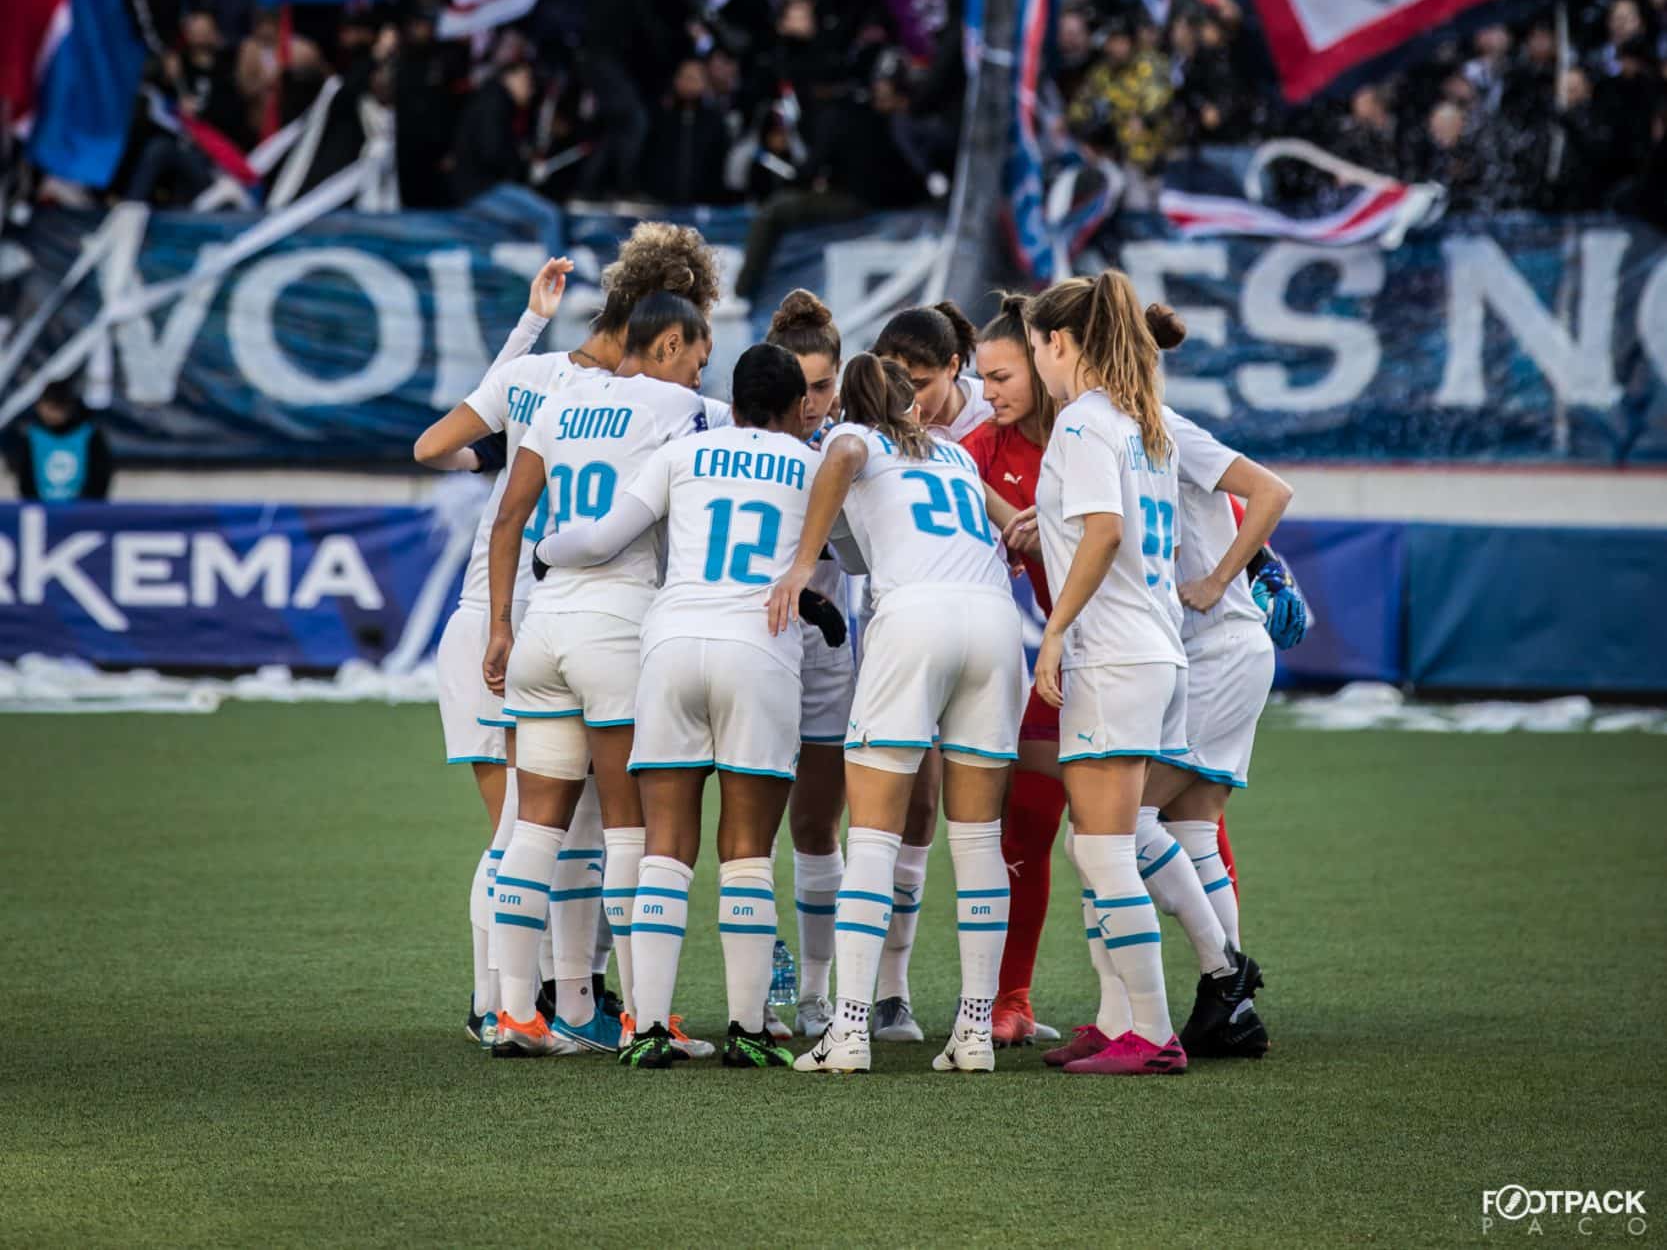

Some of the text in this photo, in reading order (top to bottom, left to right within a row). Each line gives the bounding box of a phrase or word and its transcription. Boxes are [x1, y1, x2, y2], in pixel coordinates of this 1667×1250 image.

[1437, 230, 1667, 410] N
[555, 407, 633, 441] SUMO
[694, 448, 806, 491] CARDIA
[902, 469, 995, 547] 20
[0, 505, 386, 632] KEMA
[703, 497, 782, 585] 12
